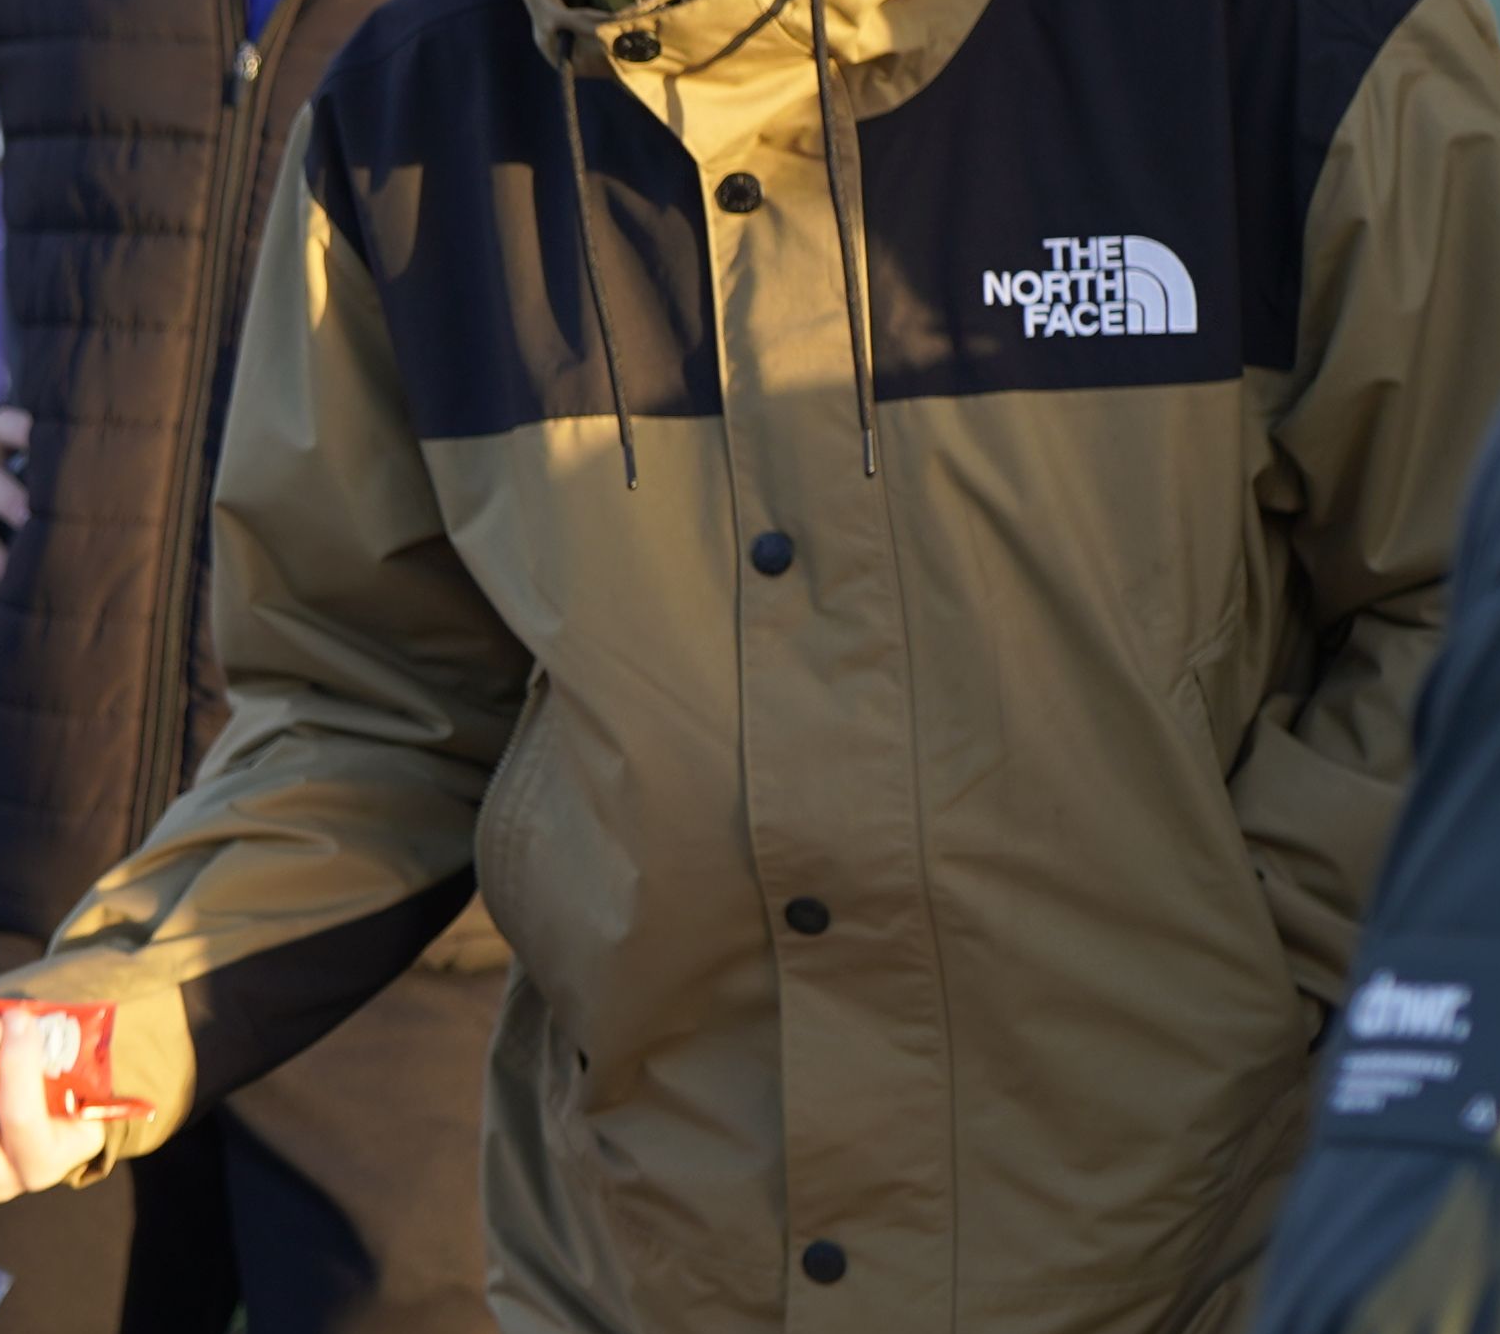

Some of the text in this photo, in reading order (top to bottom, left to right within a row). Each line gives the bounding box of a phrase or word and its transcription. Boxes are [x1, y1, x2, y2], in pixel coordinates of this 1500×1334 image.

[1042, 234, 1123, 270] THE
[982, 267, 1125, 307] NORTH
[1023, 301, 1126, 339] FACE
